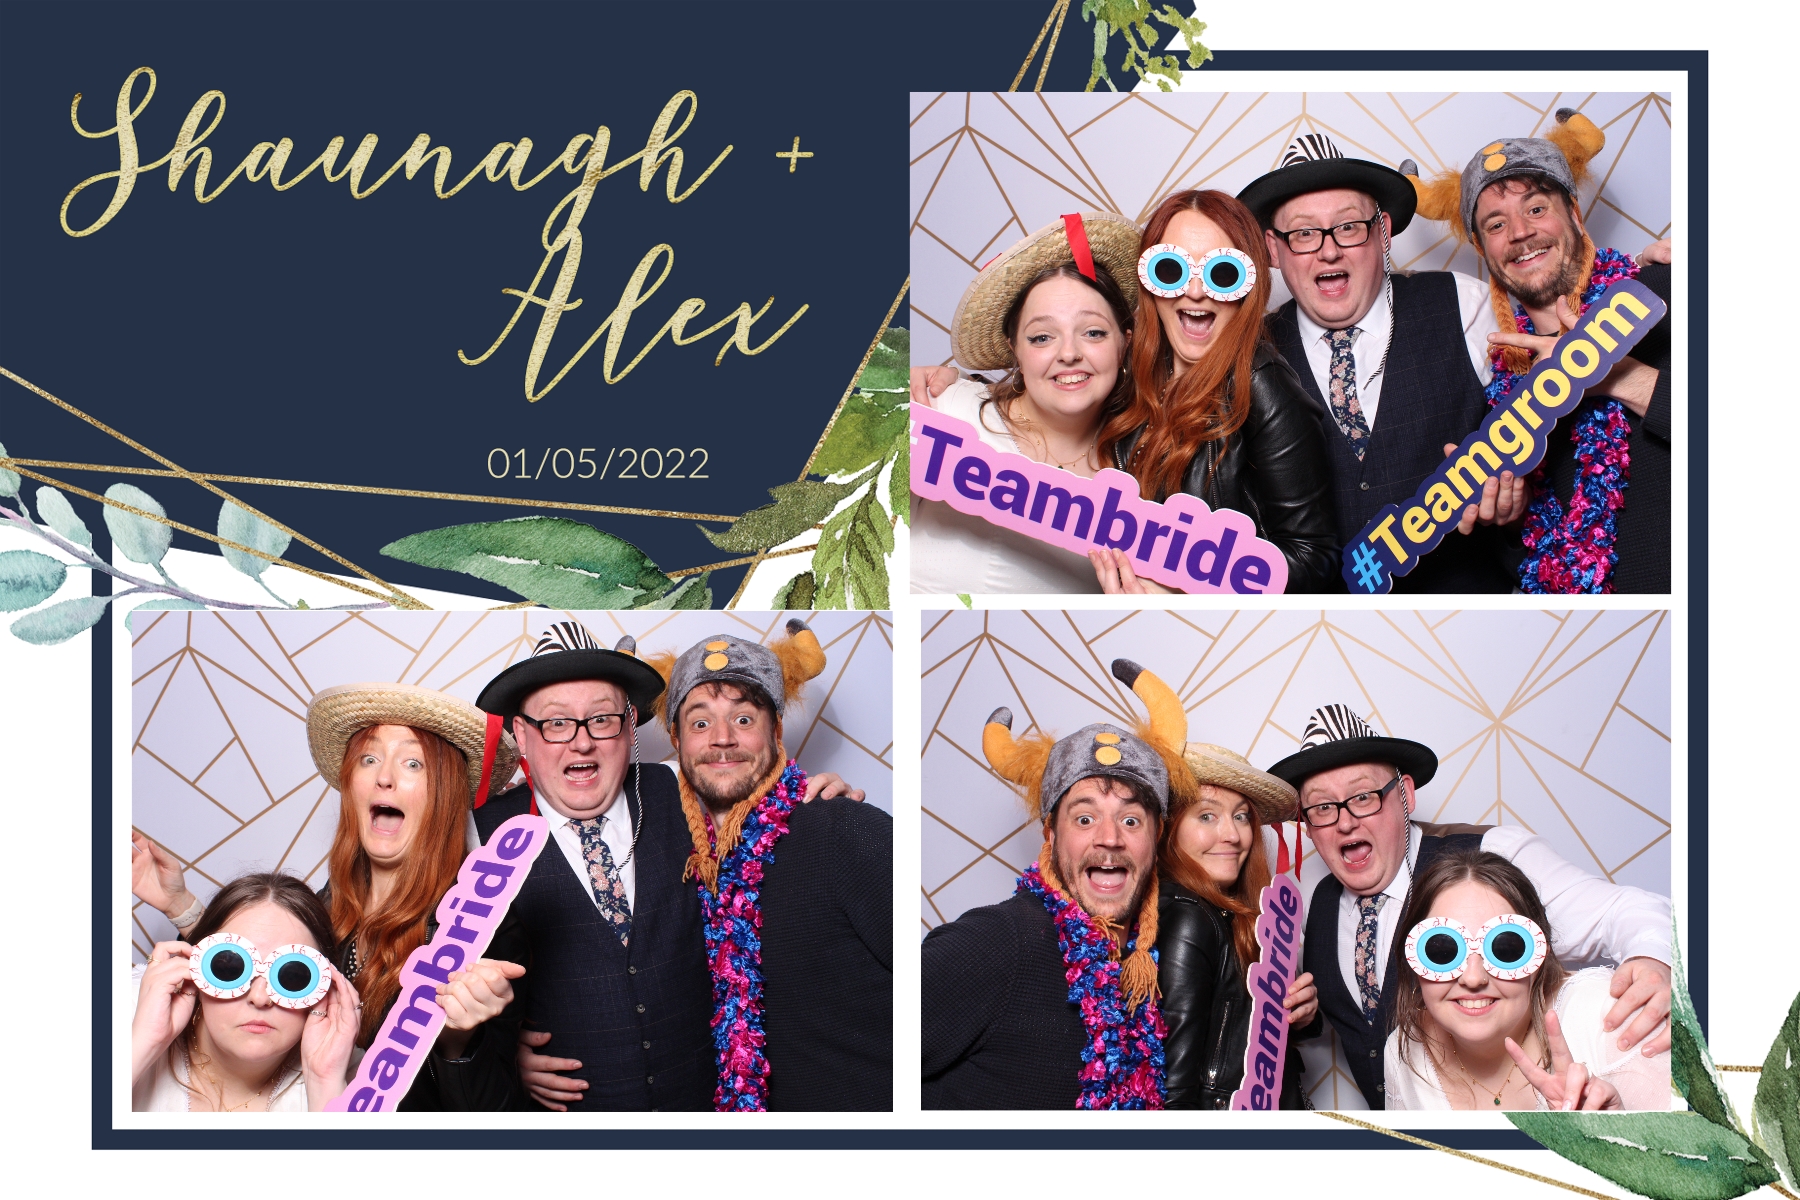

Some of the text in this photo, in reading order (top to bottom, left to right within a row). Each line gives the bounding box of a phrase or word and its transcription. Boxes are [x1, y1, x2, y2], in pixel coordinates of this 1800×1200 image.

[910, 420, 1272, 594] Teambride
[1351, 291, 1651, 593] #Teamgroom
[1241, 885, 1297, 1110] eambride
